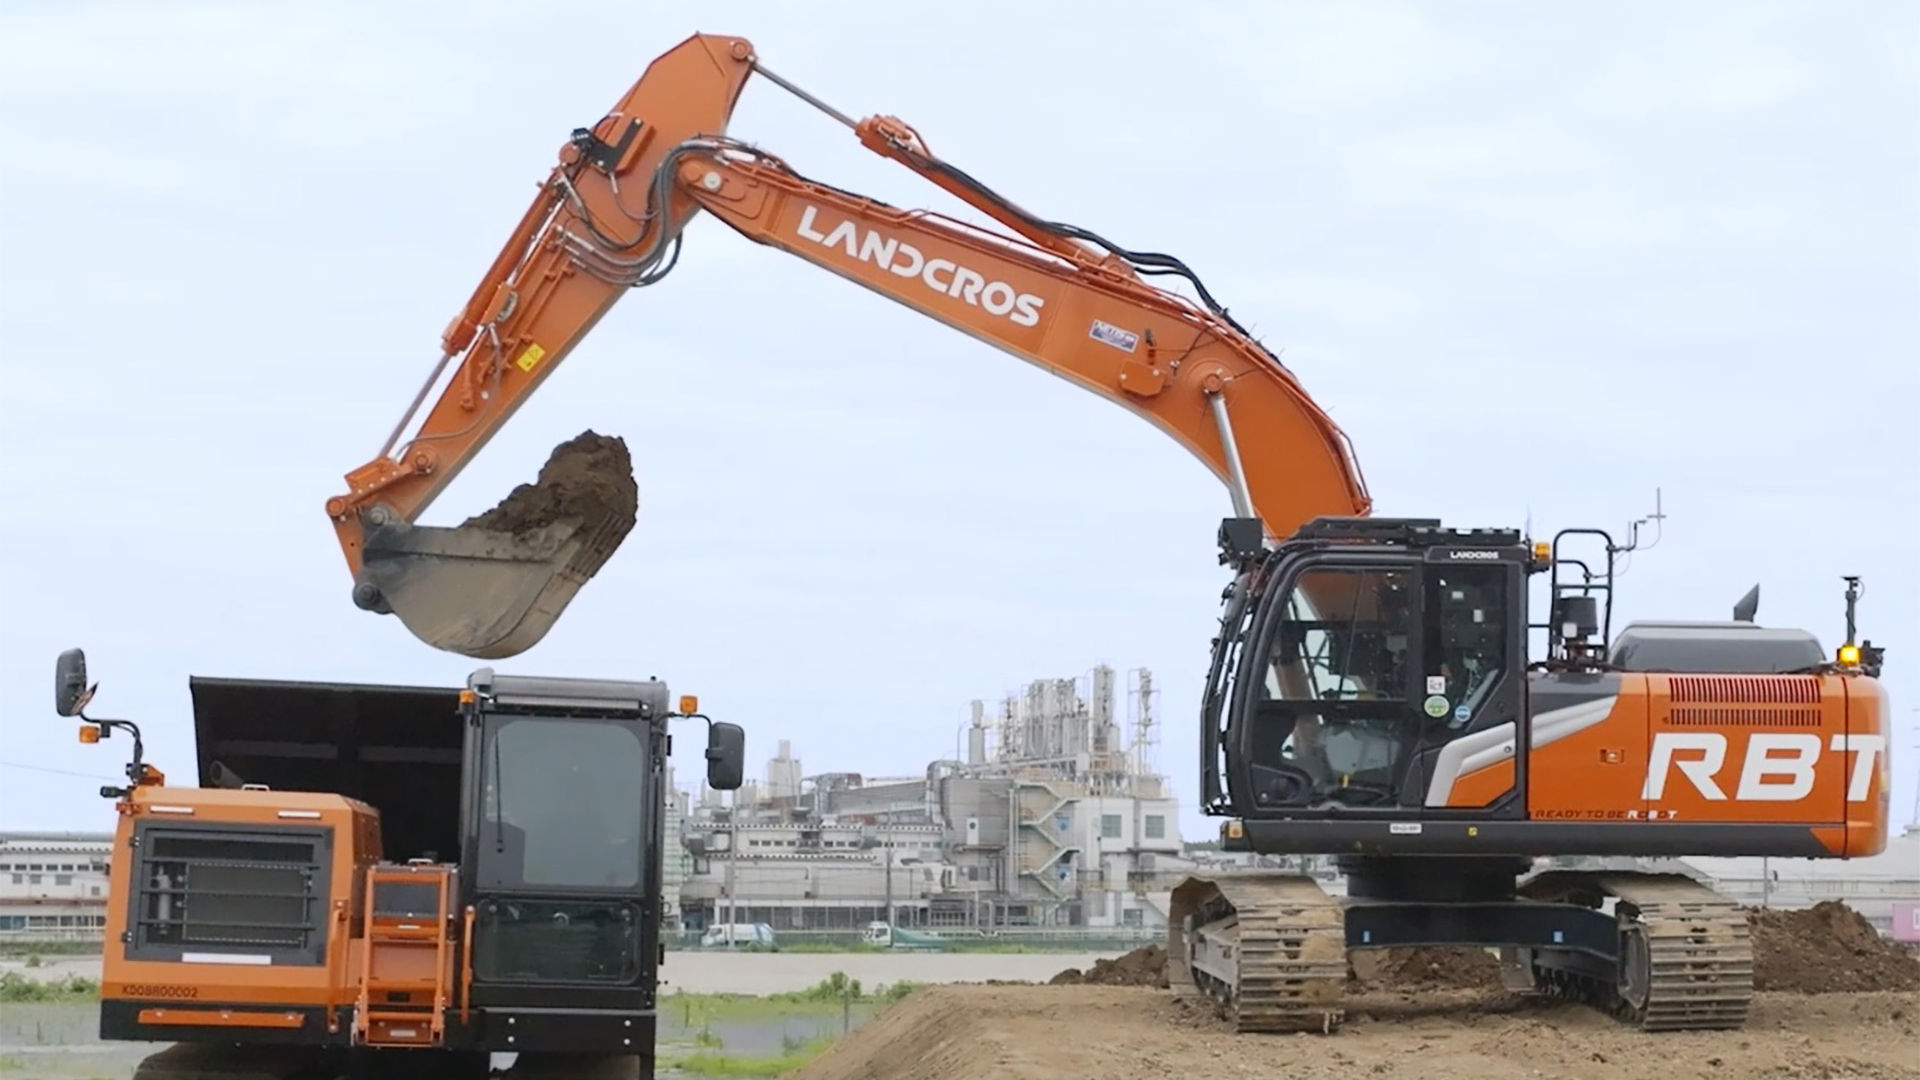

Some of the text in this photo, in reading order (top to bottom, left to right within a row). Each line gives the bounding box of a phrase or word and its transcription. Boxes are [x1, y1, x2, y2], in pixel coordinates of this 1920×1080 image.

[796, 205, 1045, 328] LANDCROS
[1641, 733, 1886, 801] RBT
[1534, 809, 1678, 819] READY TO BE ROBOT
